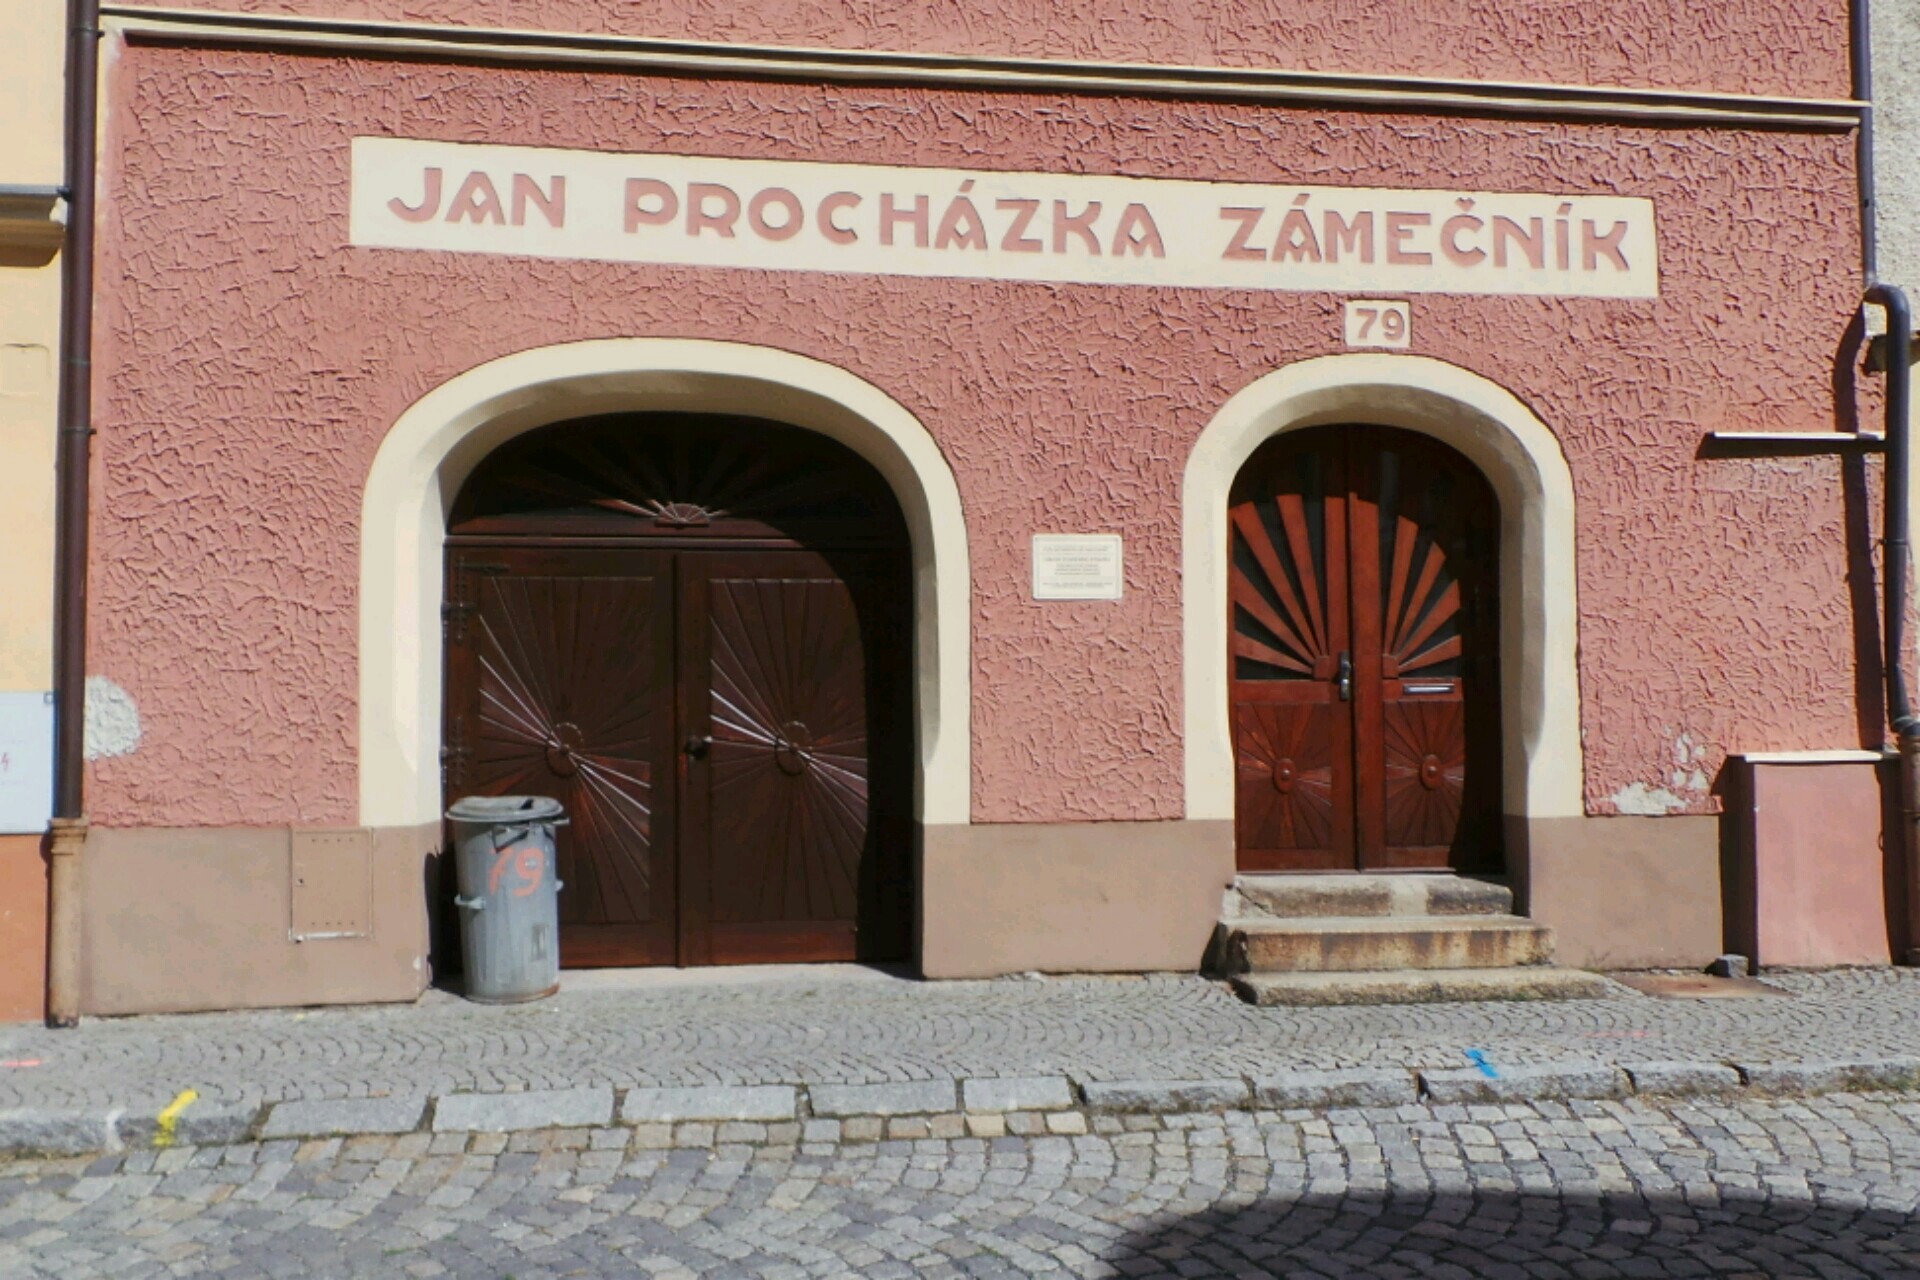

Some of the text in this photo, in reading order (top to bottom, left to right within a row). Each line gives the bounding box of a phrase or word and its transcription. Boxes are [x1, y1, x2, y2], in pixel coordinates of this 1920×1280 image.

[387, 167, 1630, 273] JAN PROCHÁZKA ZÁMEČNÍK
[1355, 308, 1405, 342] 79
[489, 847, 544, 897] 79
